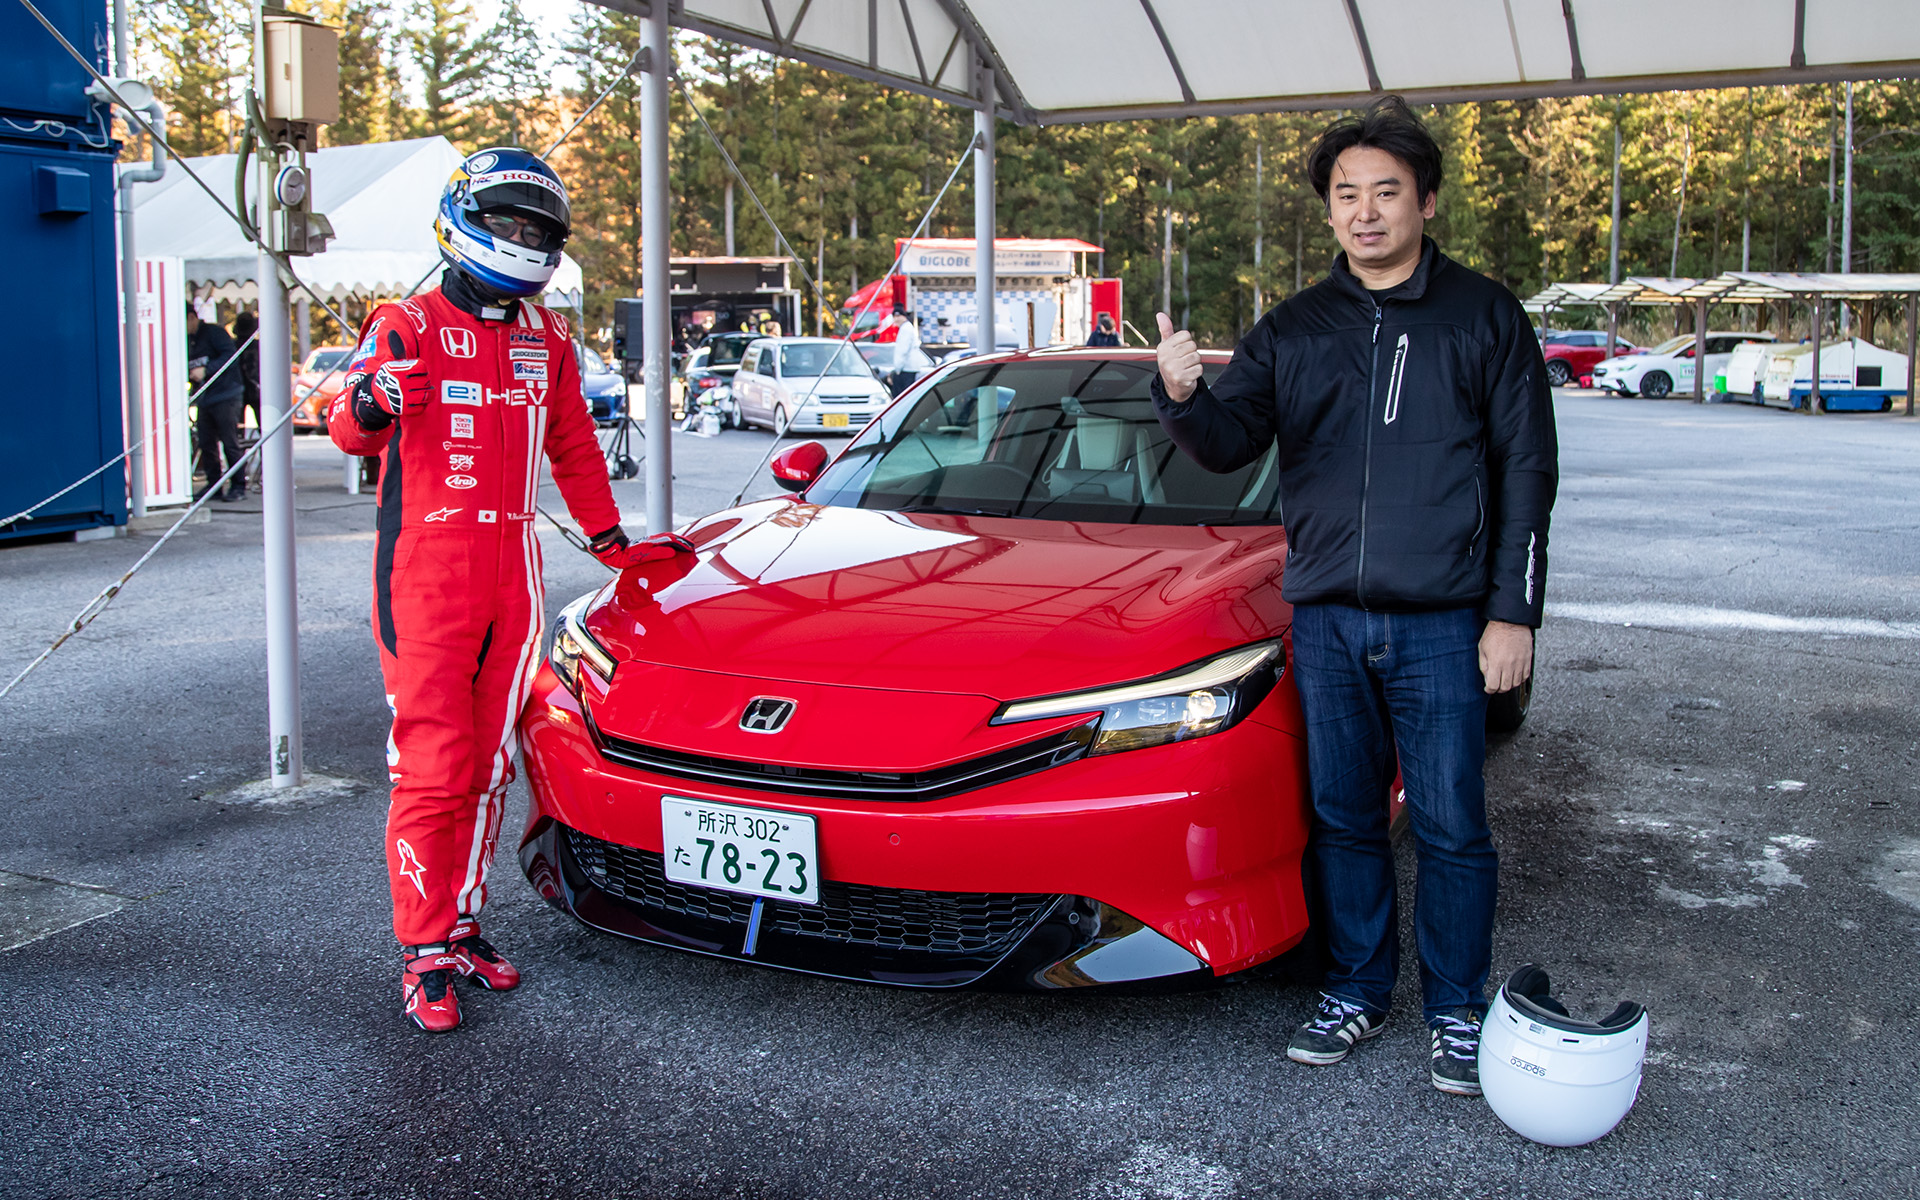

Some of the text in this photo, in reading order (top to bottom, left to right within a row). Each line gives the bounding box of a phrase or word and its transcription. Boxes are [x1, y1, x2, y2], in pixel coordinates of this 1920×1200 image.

[502, 173, 564, 199] HONDA
[919, 256, 971, 267] BIGLOBE
[510, 328, 546, 343] HRC
[486, 387, 548, 406] HEV
[448, 454, 475, 466] SPK
[452, 476, 473, 486] Arai
[698, 810, 781, 842] 所沢 302
[674, 837, 808, 895] た 78-23
[1510, 1057, 1547, 1077] sparco
